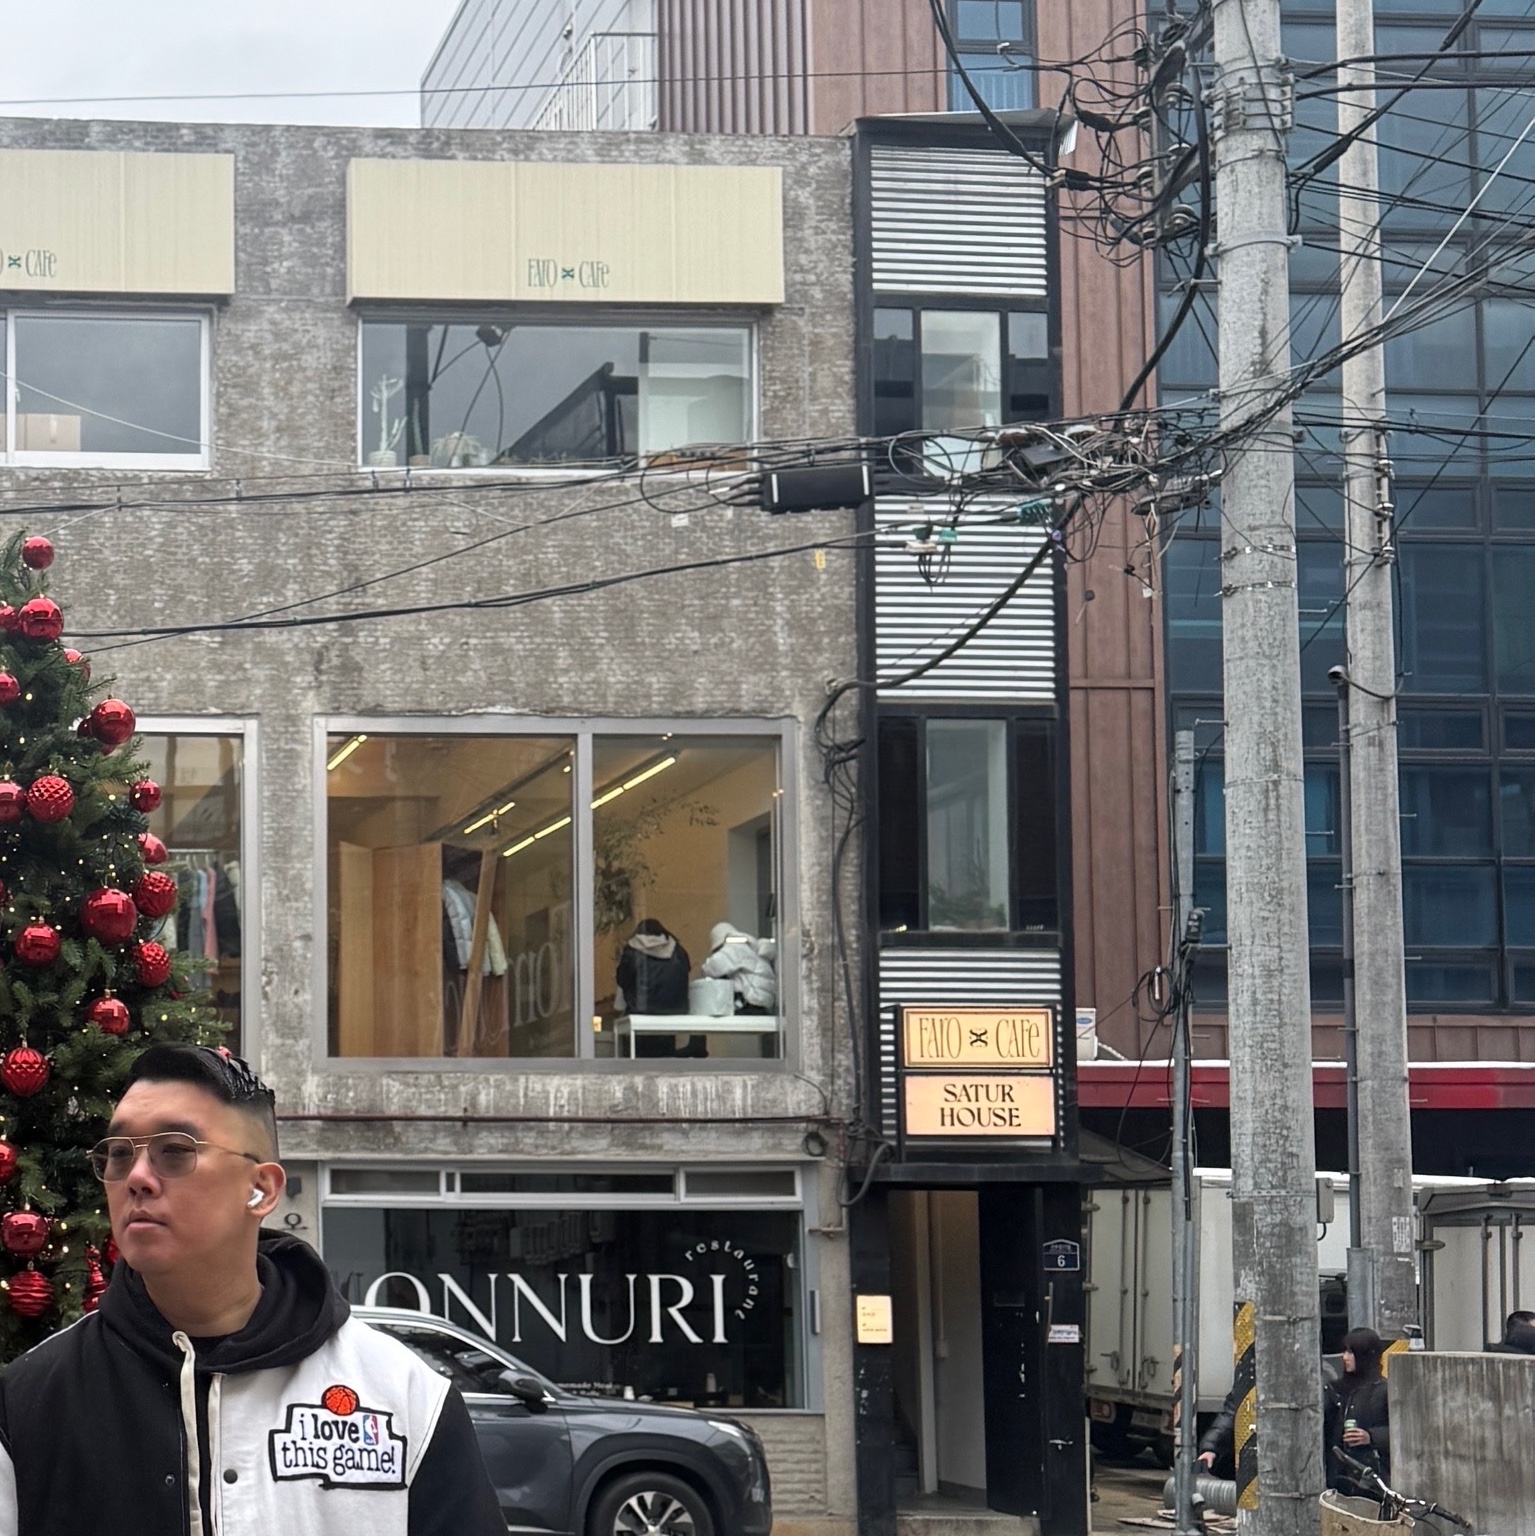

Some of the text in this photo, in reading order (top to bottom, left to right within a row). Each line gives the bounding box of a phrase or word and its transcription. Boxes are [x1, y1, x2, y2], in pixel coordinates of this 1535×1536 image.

[943, 1083, 1015, 1104] SATUR
[939, 1107, 1022, 1128] HOUSE
[1057, 1254, 1066, 1267] 6
[684, 1239, 759, 1320] restaurant
[311, 1413, 360, 1444] love
[281, 1440, 397, 1477] this game!
